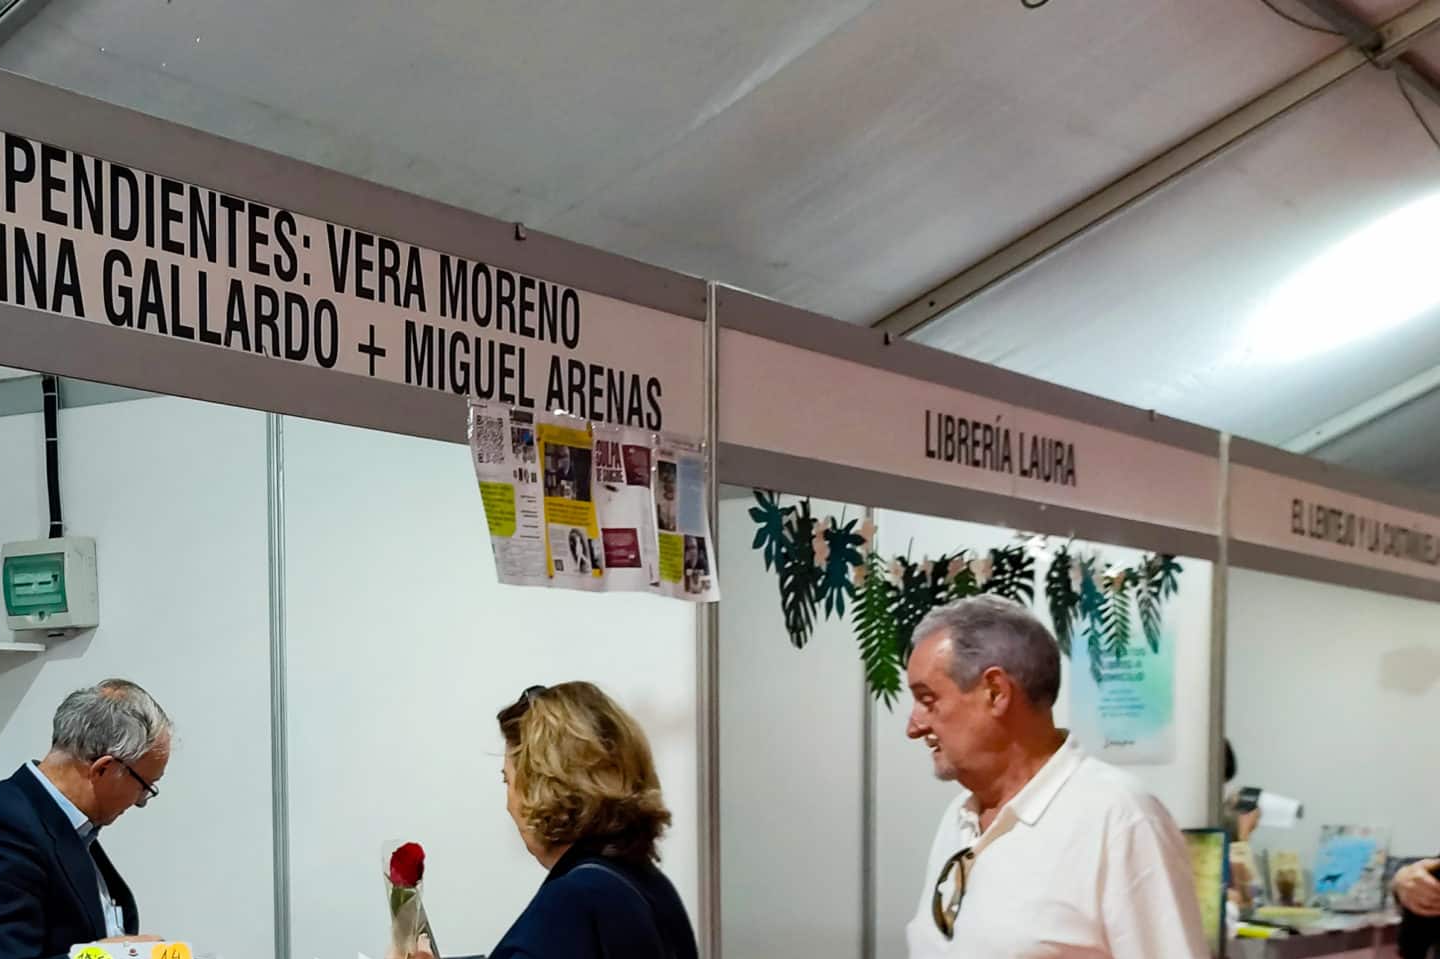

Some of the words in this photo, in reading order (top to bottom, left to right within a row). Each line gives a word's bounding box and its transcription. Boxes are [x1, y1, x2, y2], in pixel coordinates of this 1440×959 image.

[103, 249, 339, 369] GALLARDO
[358, 324, 386, 376] +
[404, 319, 536, 408] MIGUEL
[545, 355, 663, 432] ARENAS
[326, 222, 427, 313] VERA
[439, 254, 581, 350] MORENO
[925, 409, 1013, 474] LIBRERÍA
[1018, 431, 1077, 487] LAURA
